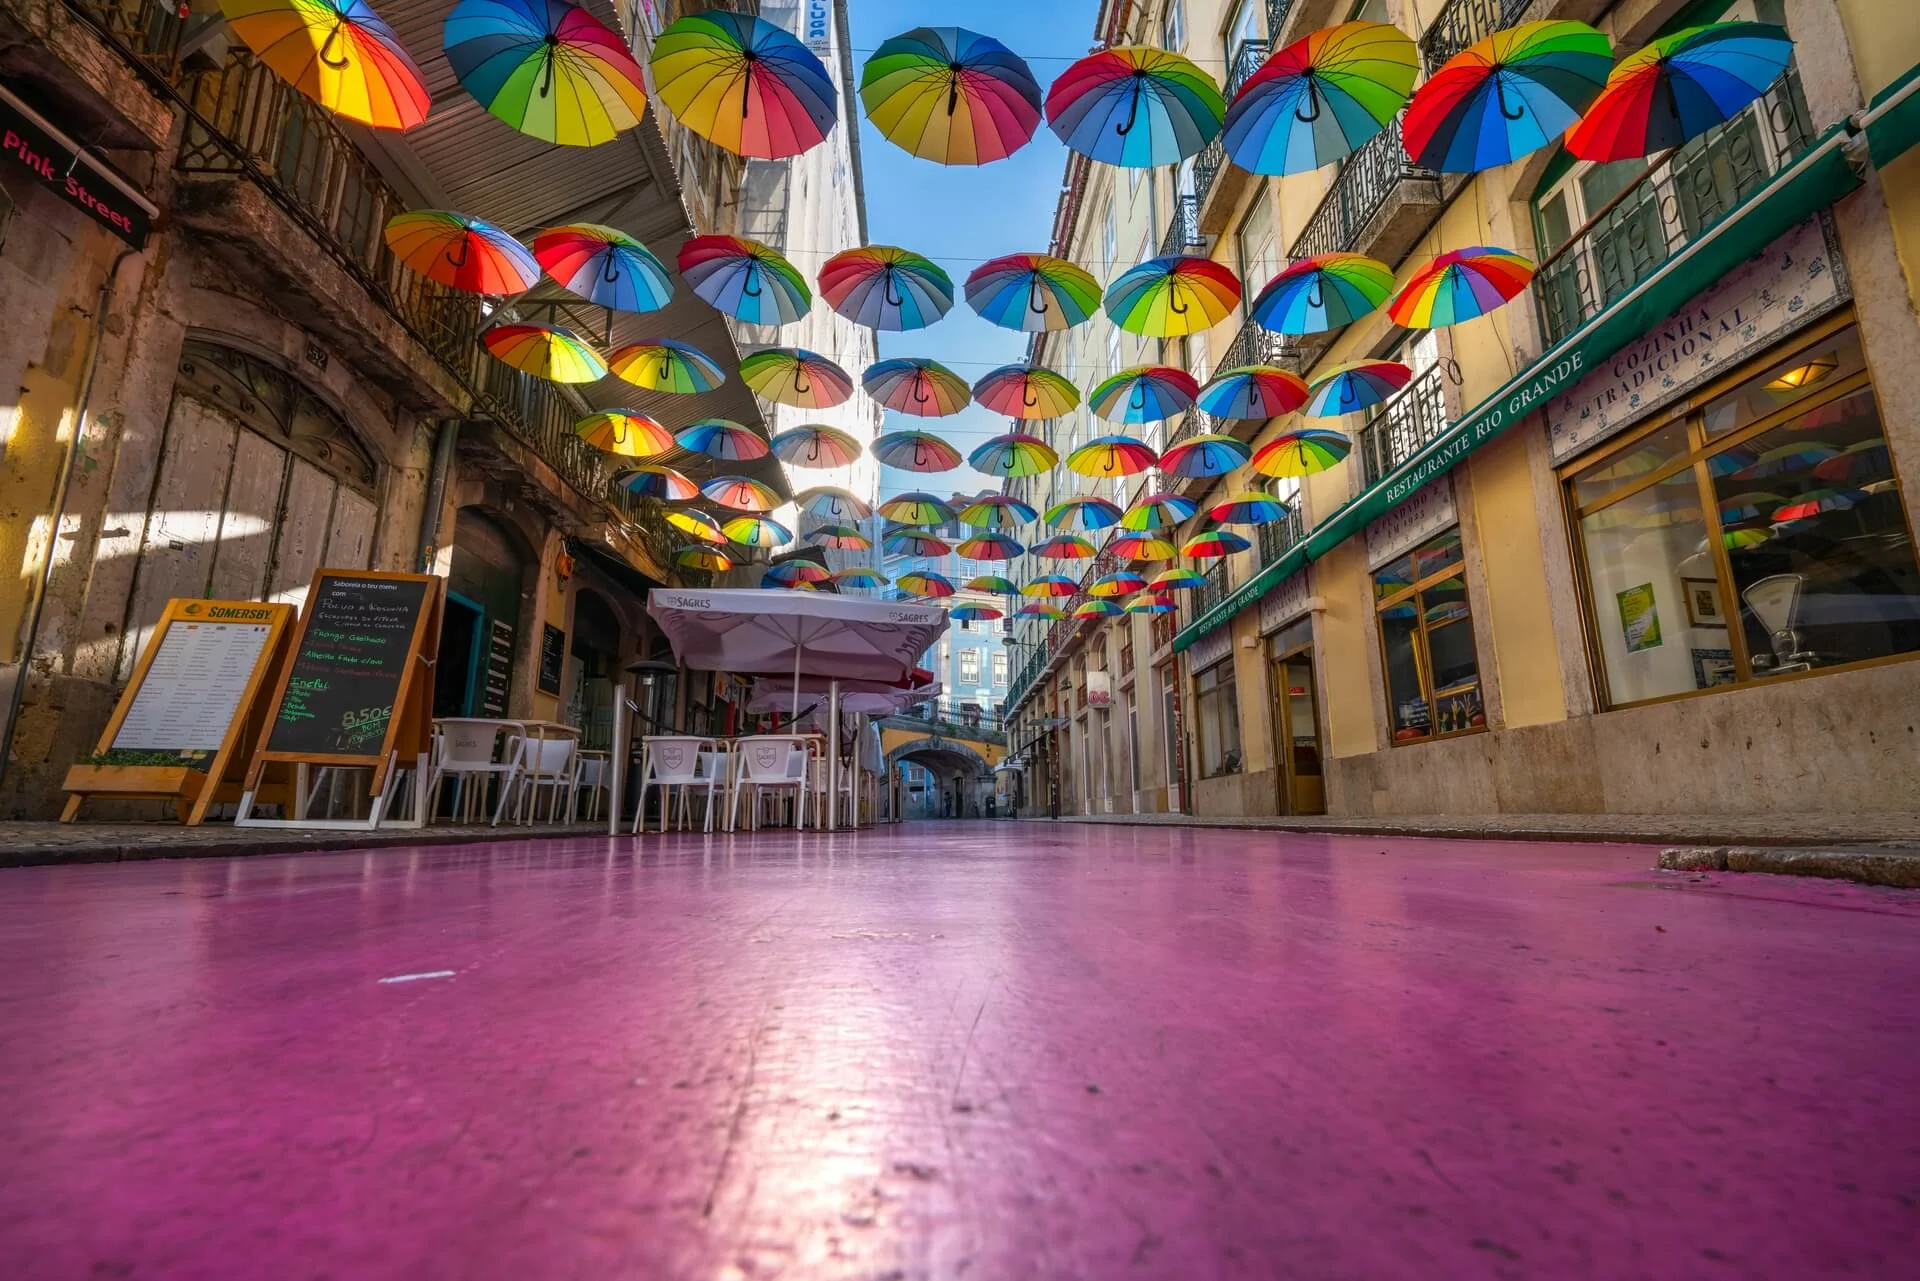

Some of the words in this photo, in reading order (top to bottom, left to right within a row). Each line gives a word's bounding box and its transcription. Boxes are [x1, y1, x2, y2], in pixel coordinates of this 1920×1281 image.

[809, 0, 826, 38] LUGA
[3, 129, 55, 181] Pink
[64, 177, 132, 233] Street
[1595, 308, 1748, 410] TRADICIONAL
[1613, 307, 1710, 378] COZINHA
[1386, 434, 1470, 503] RESTAURANTE
[1475, 410, 1502, 440] RIO
[1509, 351, 1583, 415] GRANDE
[208, 606, 272, 620] SOMERSBY
[677, 597, 711, 609] SAGRES
[898, 612, 929, 623] SAGRES
